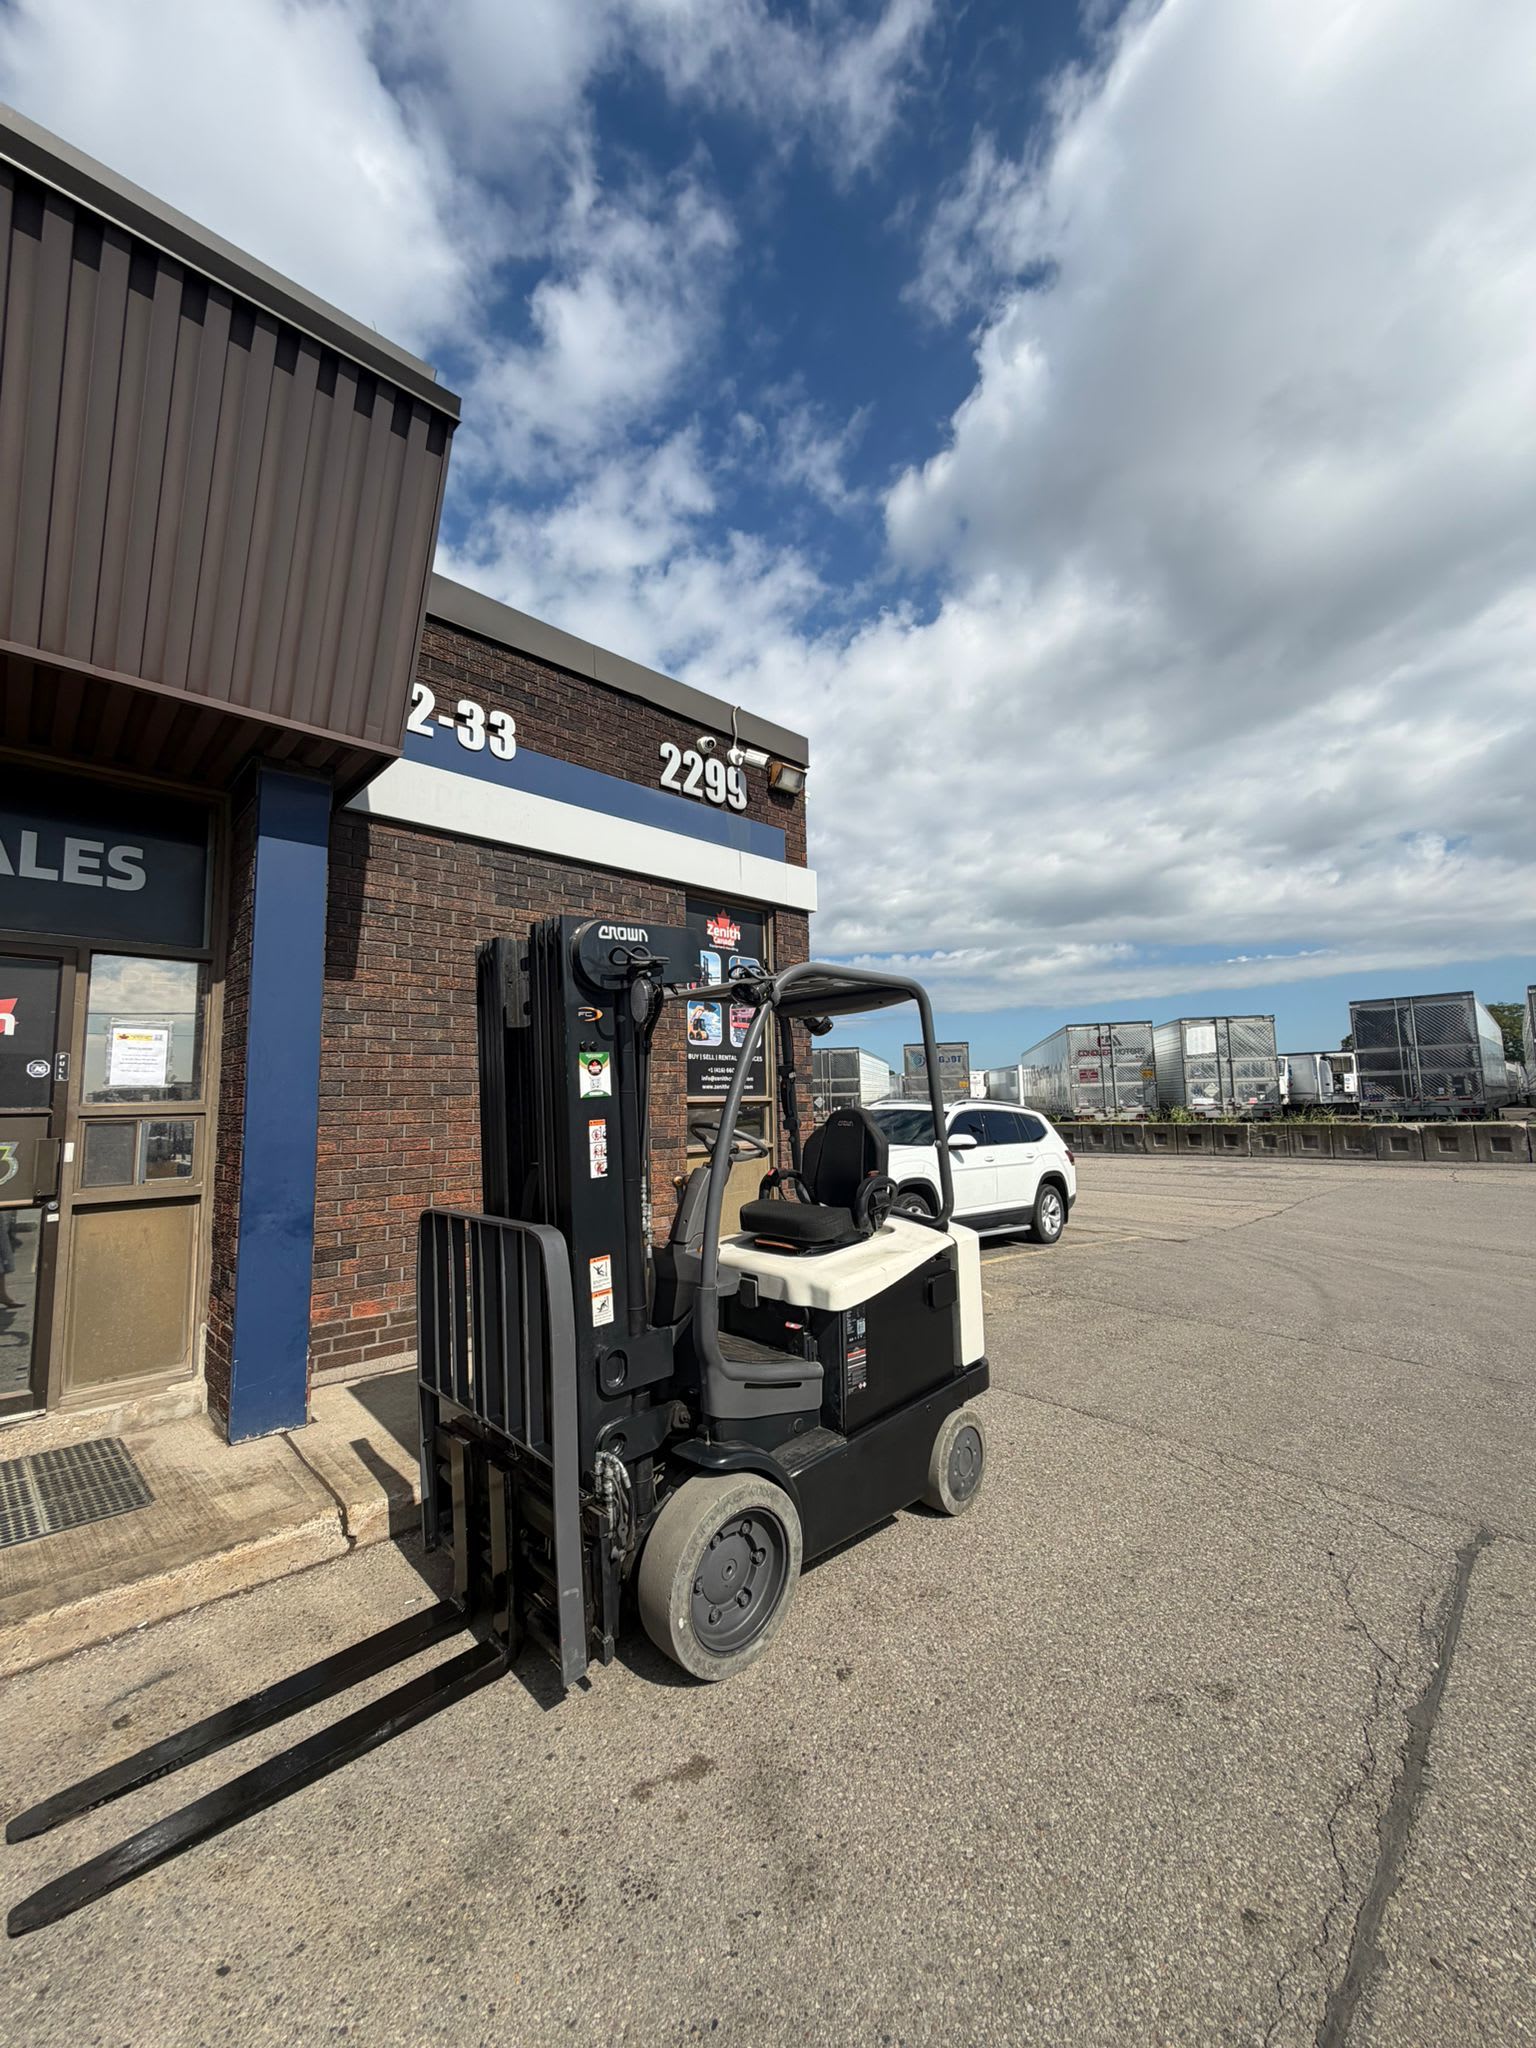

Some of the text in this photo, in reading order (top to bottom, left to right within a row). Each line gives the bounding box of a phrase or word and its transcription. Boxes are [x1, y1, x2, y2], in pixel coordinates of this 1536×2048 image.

[659, 741, 748, 810] 2299
[0, 830, 146, 891] LES
[706, 923, 741, 941] Zenith
[57, 1054, 66, 1080] PULL
[702, 1053, 715, 1061] SELL
[718, 1054, 738, 1062] RENTAL
